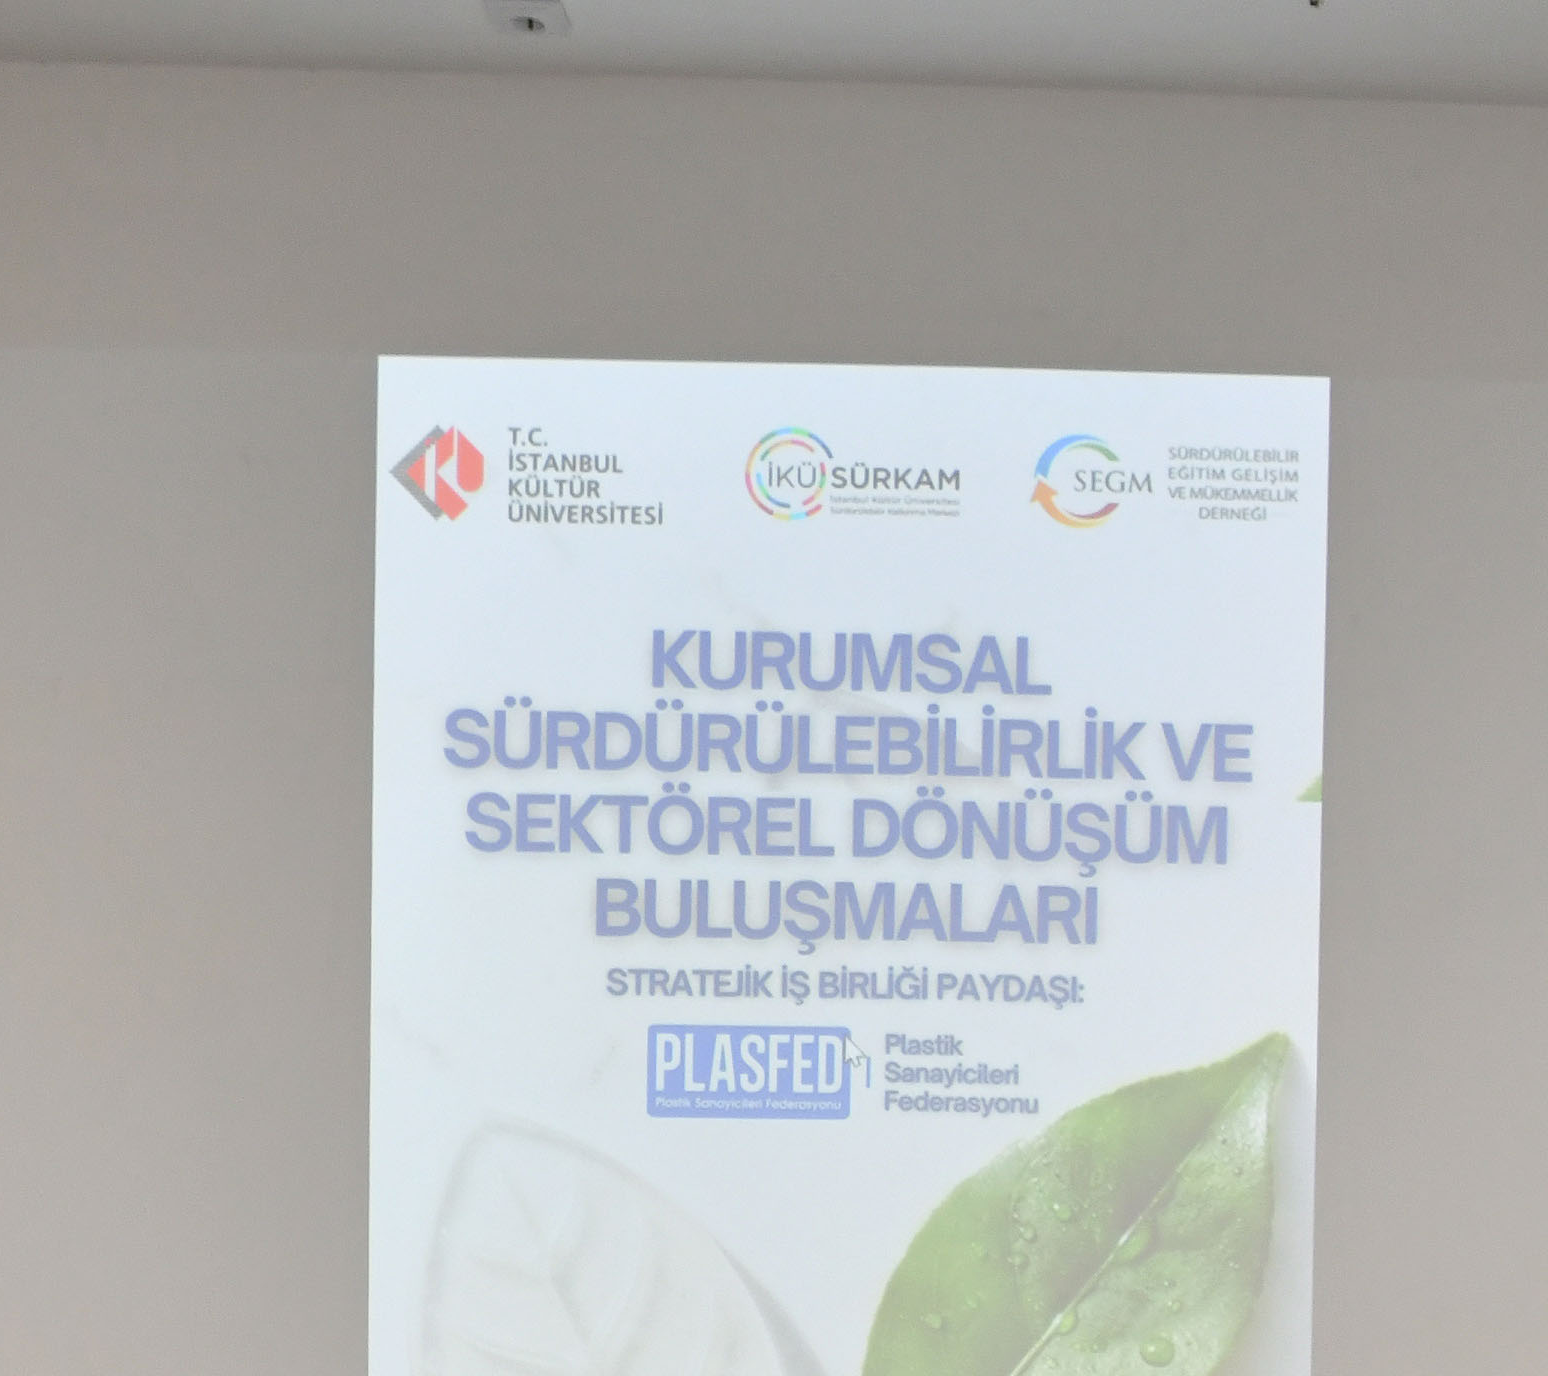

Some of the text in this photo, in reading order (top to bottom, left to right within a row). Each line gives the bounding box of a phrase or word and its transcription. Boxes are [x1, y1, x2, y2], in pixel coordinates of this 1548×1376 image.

[508, 427, 548, 447] T.C.
[508, 449, 623, 473] İSTANBUL
[1168, 447, 1299, 463] SÜRDÜRÜLEBİLİR
[508, 475, 600, 498] KÜLTÜR
[767, 461, 960, 490] İKÜ SÜRKAM
[1073, 470, 1152, 493] SEGM
[1168, 465, 1299, 485] EĞİTİM GELİŞİM
[1168, 486, 1298, 502] VE MÜKEMMELLİK
[508, 500, 663, 525] ÜNİVERSİTESİ
[1199, 505, 1267, 521] DERNEĞİ
[651, 630, 1051, 696] KURUMSAL
[443, 696, 1254, 783] SÜRDÜRÜLEBİLİRLİK VE
[465, 781, 1229, 877] SEKTÖREL DÖNÜŞÜM
[596, 878, 1099, 955] BULUŞMALARI
[606, 965, 1084, 1010] STRATEJİK İŞ BİRLİĞİ PAYDAŞI:
[884, 1033, 964, 1056] Plastik
[655, 1032, 843, 1095] PLASFED
[884, 1062, 1019, 1088] Sanayicileri
[884, 1090, 1039, 1117] Federasyonu
